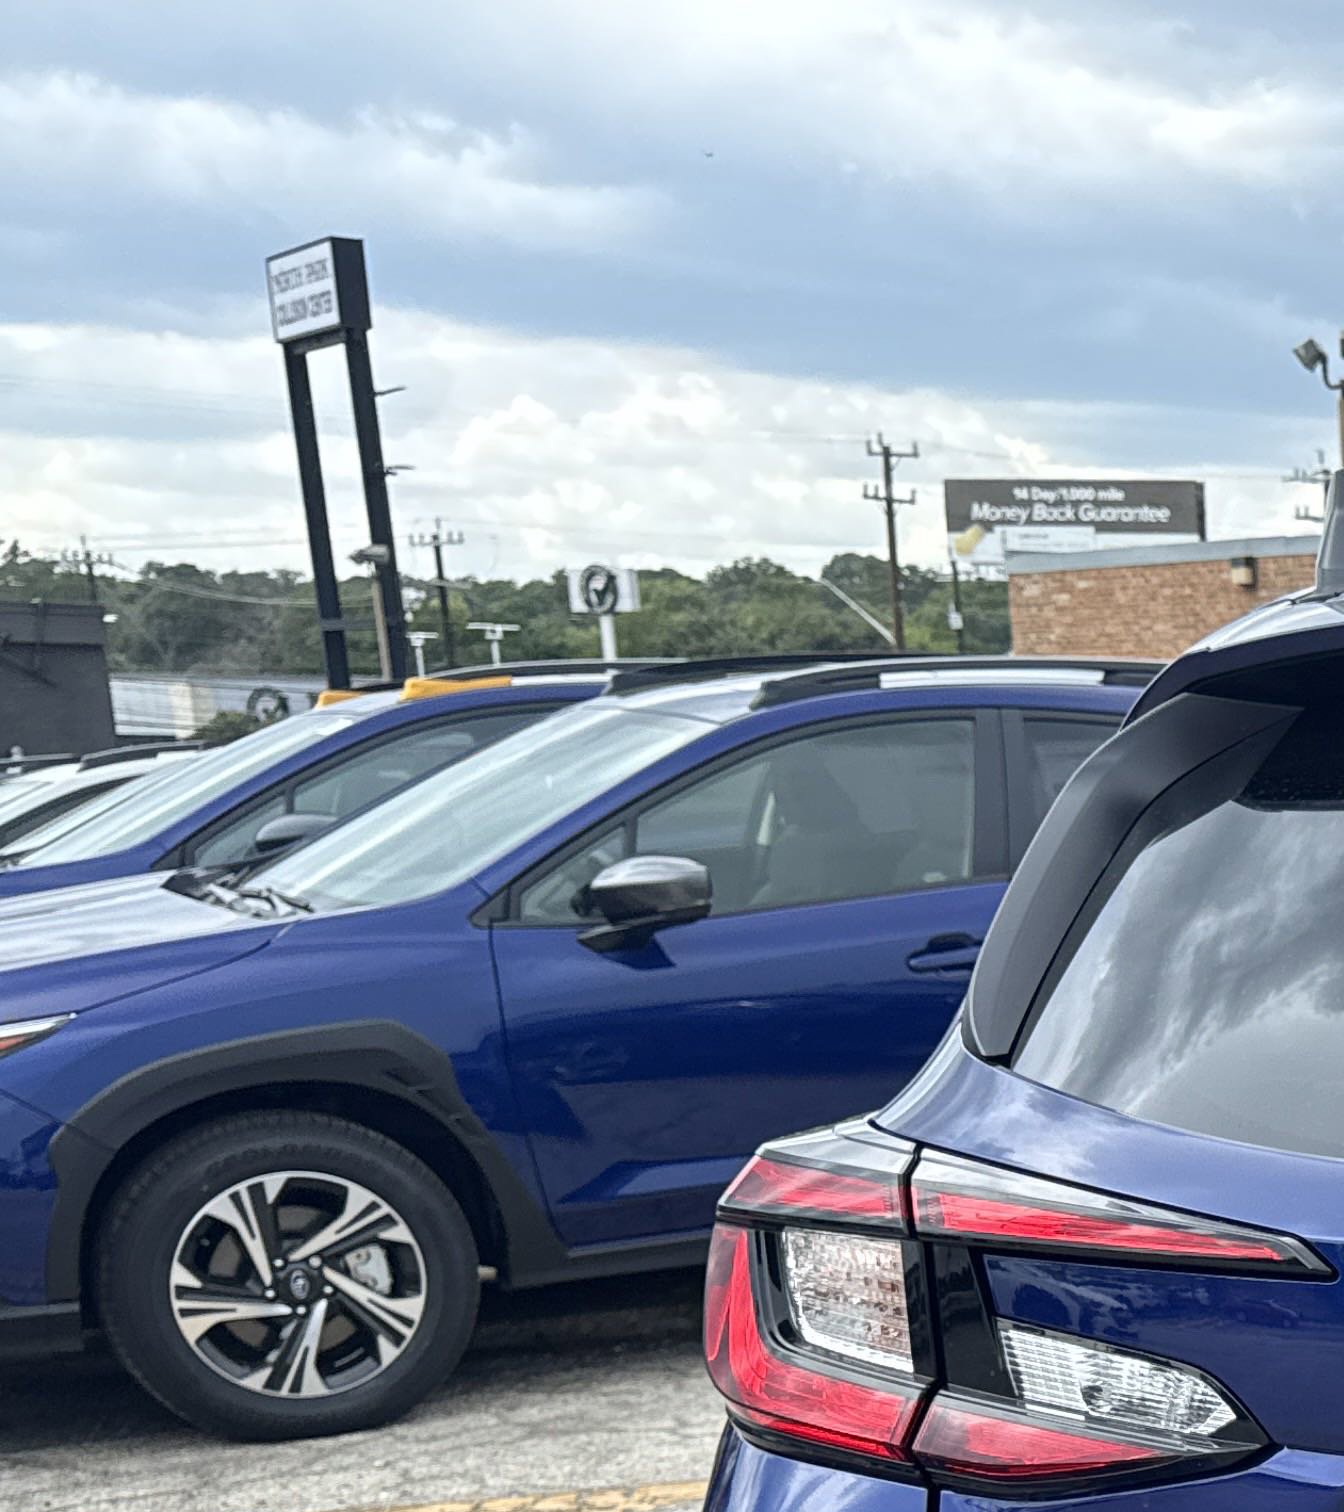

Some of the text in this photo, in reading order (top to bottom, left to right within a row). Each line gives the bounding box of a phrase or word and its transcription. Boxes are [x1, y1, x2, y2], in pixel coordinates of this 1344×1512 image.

[971, 502, 1171, 525] Money Back Guarantee
